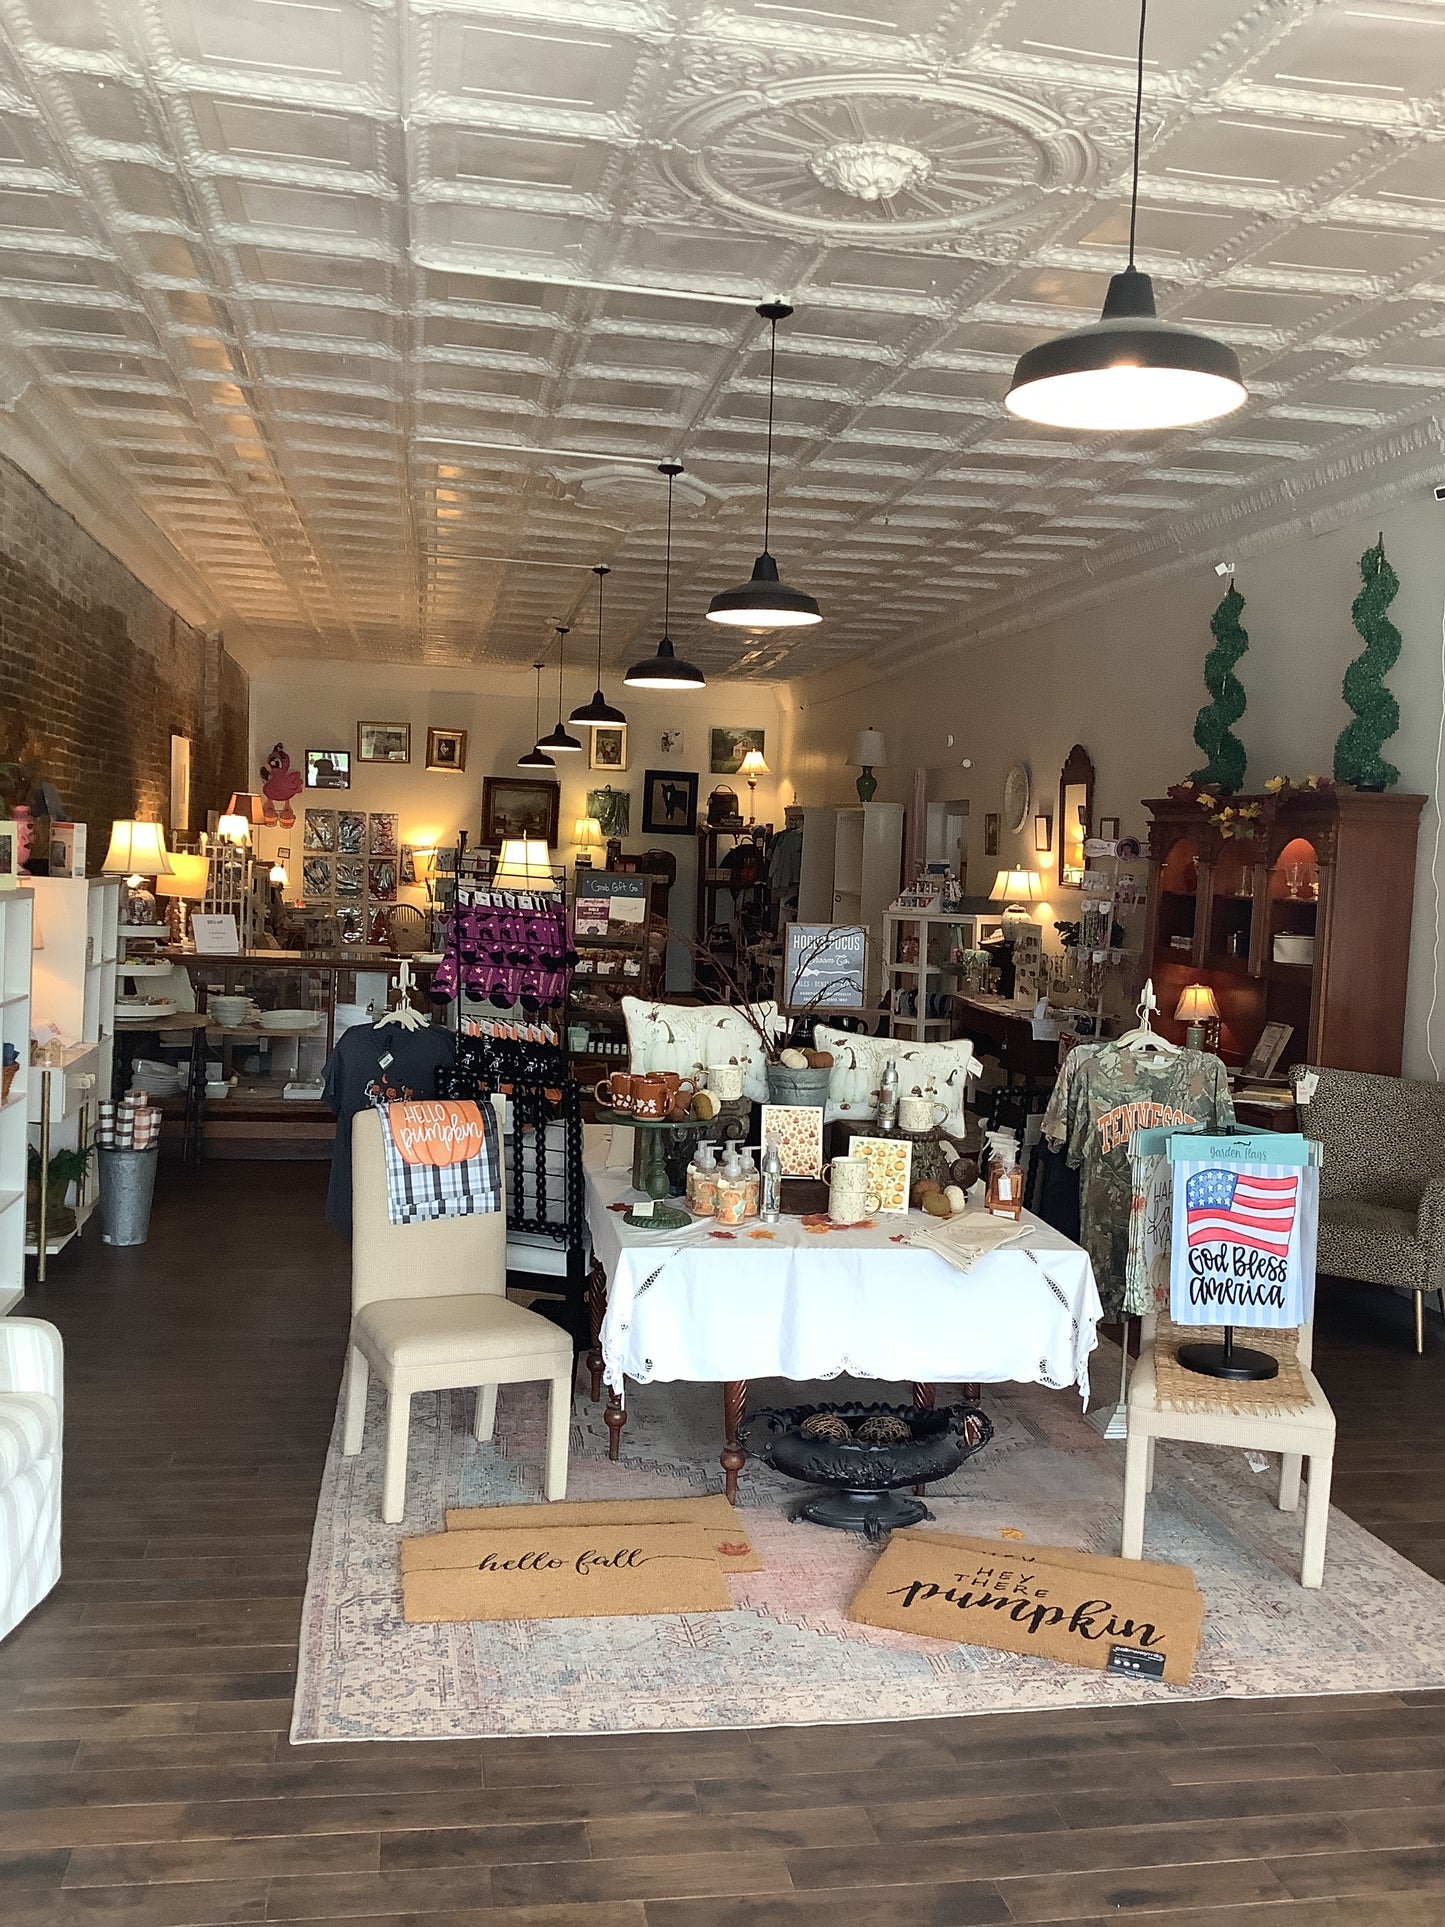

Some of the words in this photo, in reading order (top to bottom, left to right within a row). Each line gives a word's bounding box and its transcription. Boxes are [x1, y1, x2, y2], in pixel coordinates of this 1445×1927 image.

[793, 934, 826, 950] HOCUS
[828, 935, 860, 951] POCUS
[403, 1104, 446, 1123] HELLO
[400, 1114, 483, 1156] pumpkin
[1210, 1146, 1241, 1159] garden
[1244, 1147, 1268, 1161] flags
[1188, 1243, 1229, 1276] God
[1232, 1246, 1288, 1283] Bless
[477, 1551, 566, 1572] hello
[575, 1548, 648, 1576] fall
[954, 1573, 1050, 1598] THERE
[976, 1566, 1036, 1584] HEY
[886, 1580, 1166, 1647] pumpkin
